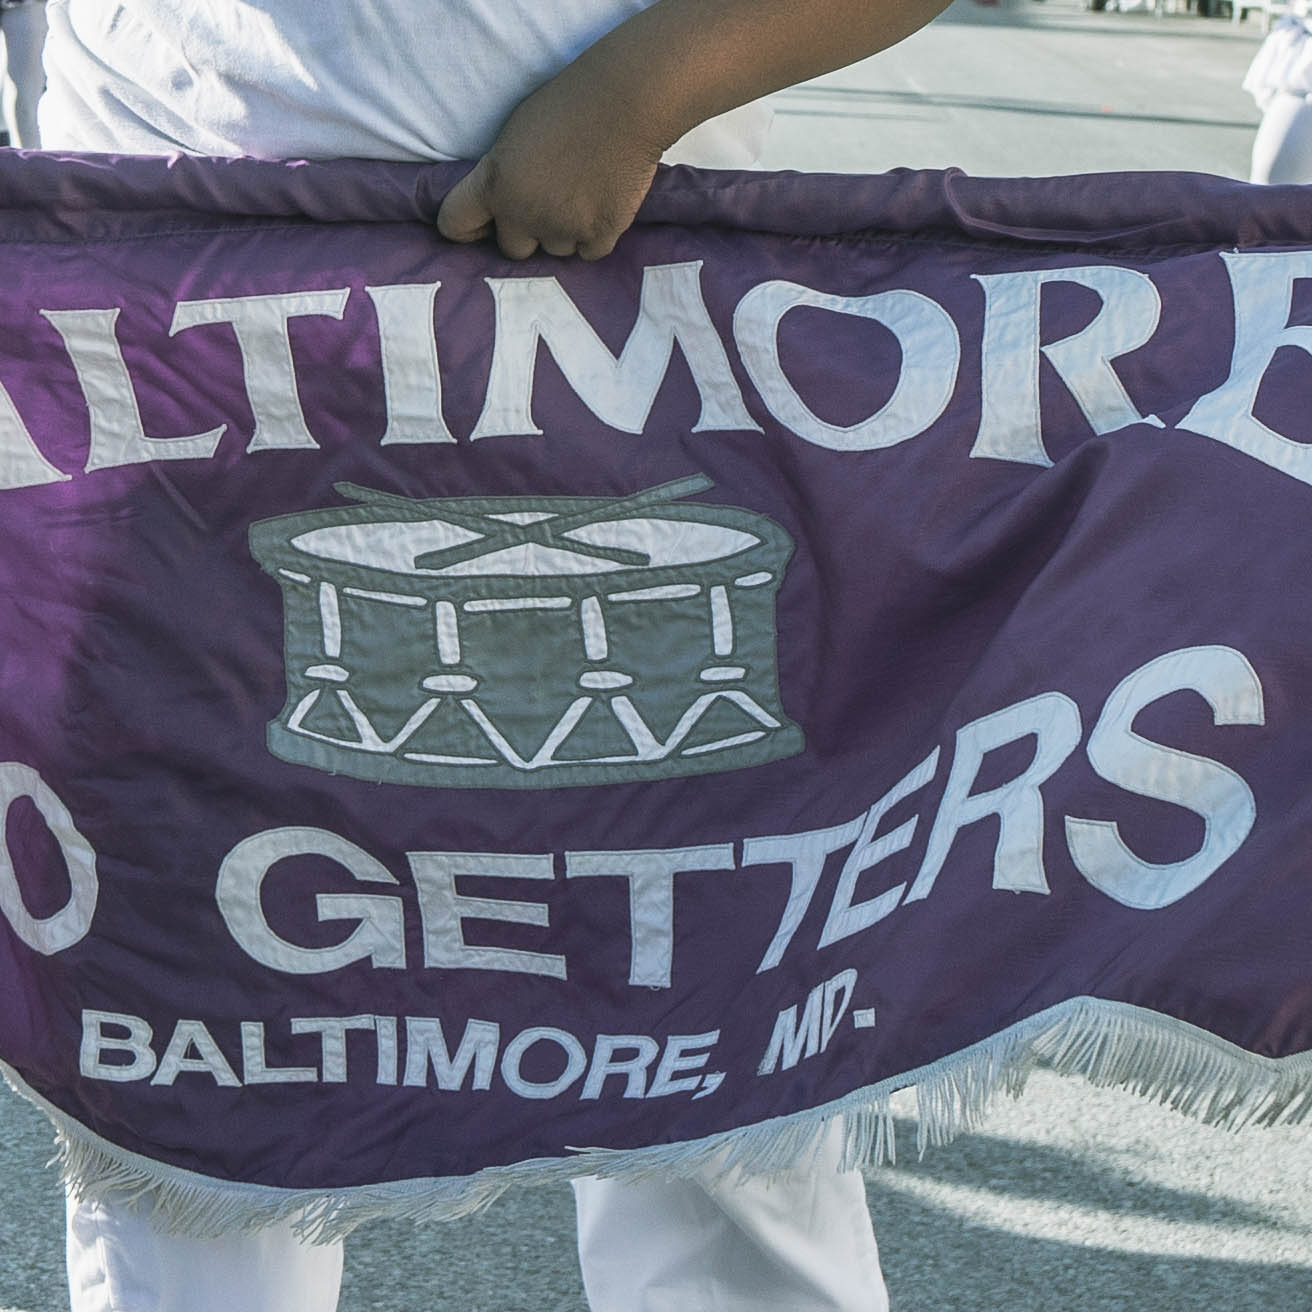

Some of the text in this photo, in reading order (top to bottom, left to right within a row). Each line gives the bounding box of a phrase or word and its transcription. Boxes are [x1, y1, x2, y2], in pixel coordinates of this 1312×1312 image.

[215, 644, 1265, 988] GETTERS
[80, 967, 876, 1101] BALTIMORE, MD.
